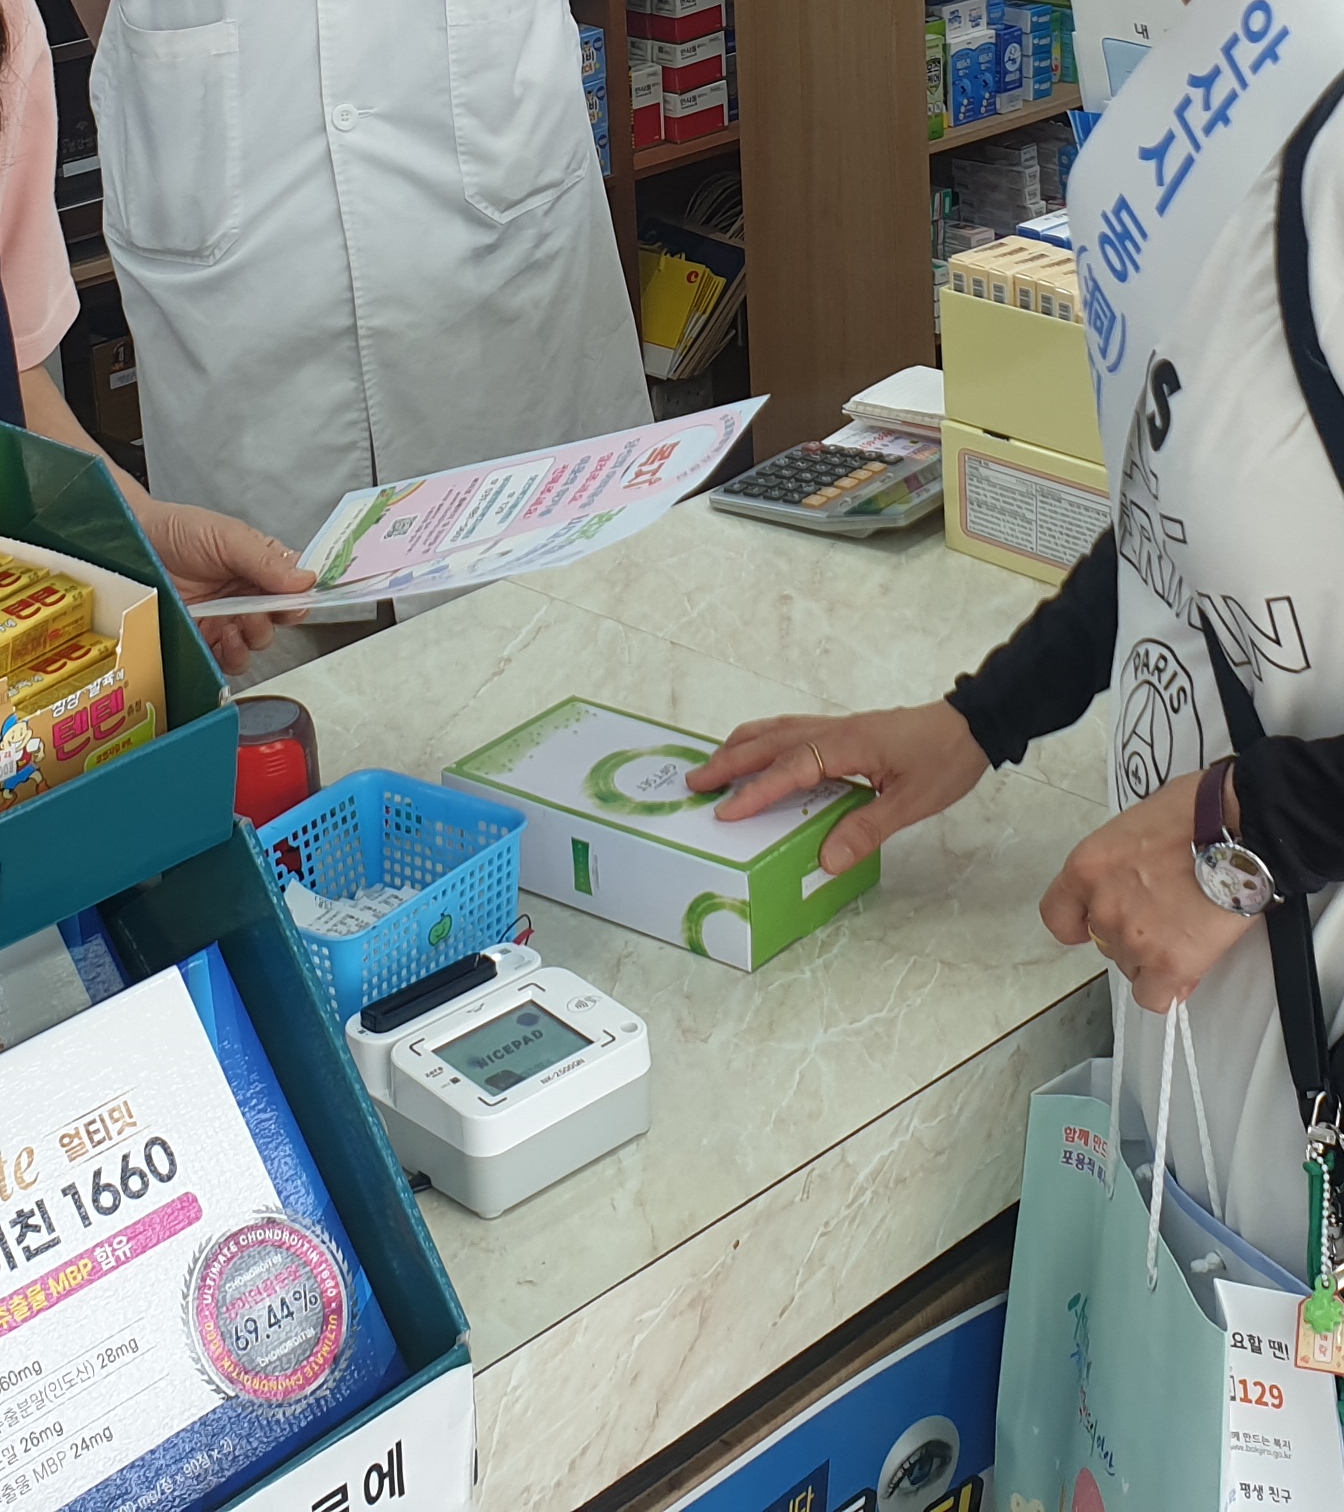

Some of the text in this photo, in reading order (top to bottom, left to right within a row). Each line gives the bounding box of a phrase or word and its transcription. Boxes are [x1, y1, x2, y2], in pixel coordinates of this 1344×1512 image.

[1133, 653, 1187, 715] PARIS
[476, 1028, 545, 1070] NICEPAD
[58, 1099, 136, 1165] 얼티밋
[61, 1136, 180, 1232] 1660
[48, 1257, 95, 1297] MBP
[91, 1237, 134, 1273] 함유
[232, 1283, 321, 1354] 69.44%
[95, 1336, 141, 1371] 28mg
[1237, 1377, 1285, 1410] 129
[19, 1418, 65, 1456] 26mg
[69, 1424, 114, 1461] 24mg
